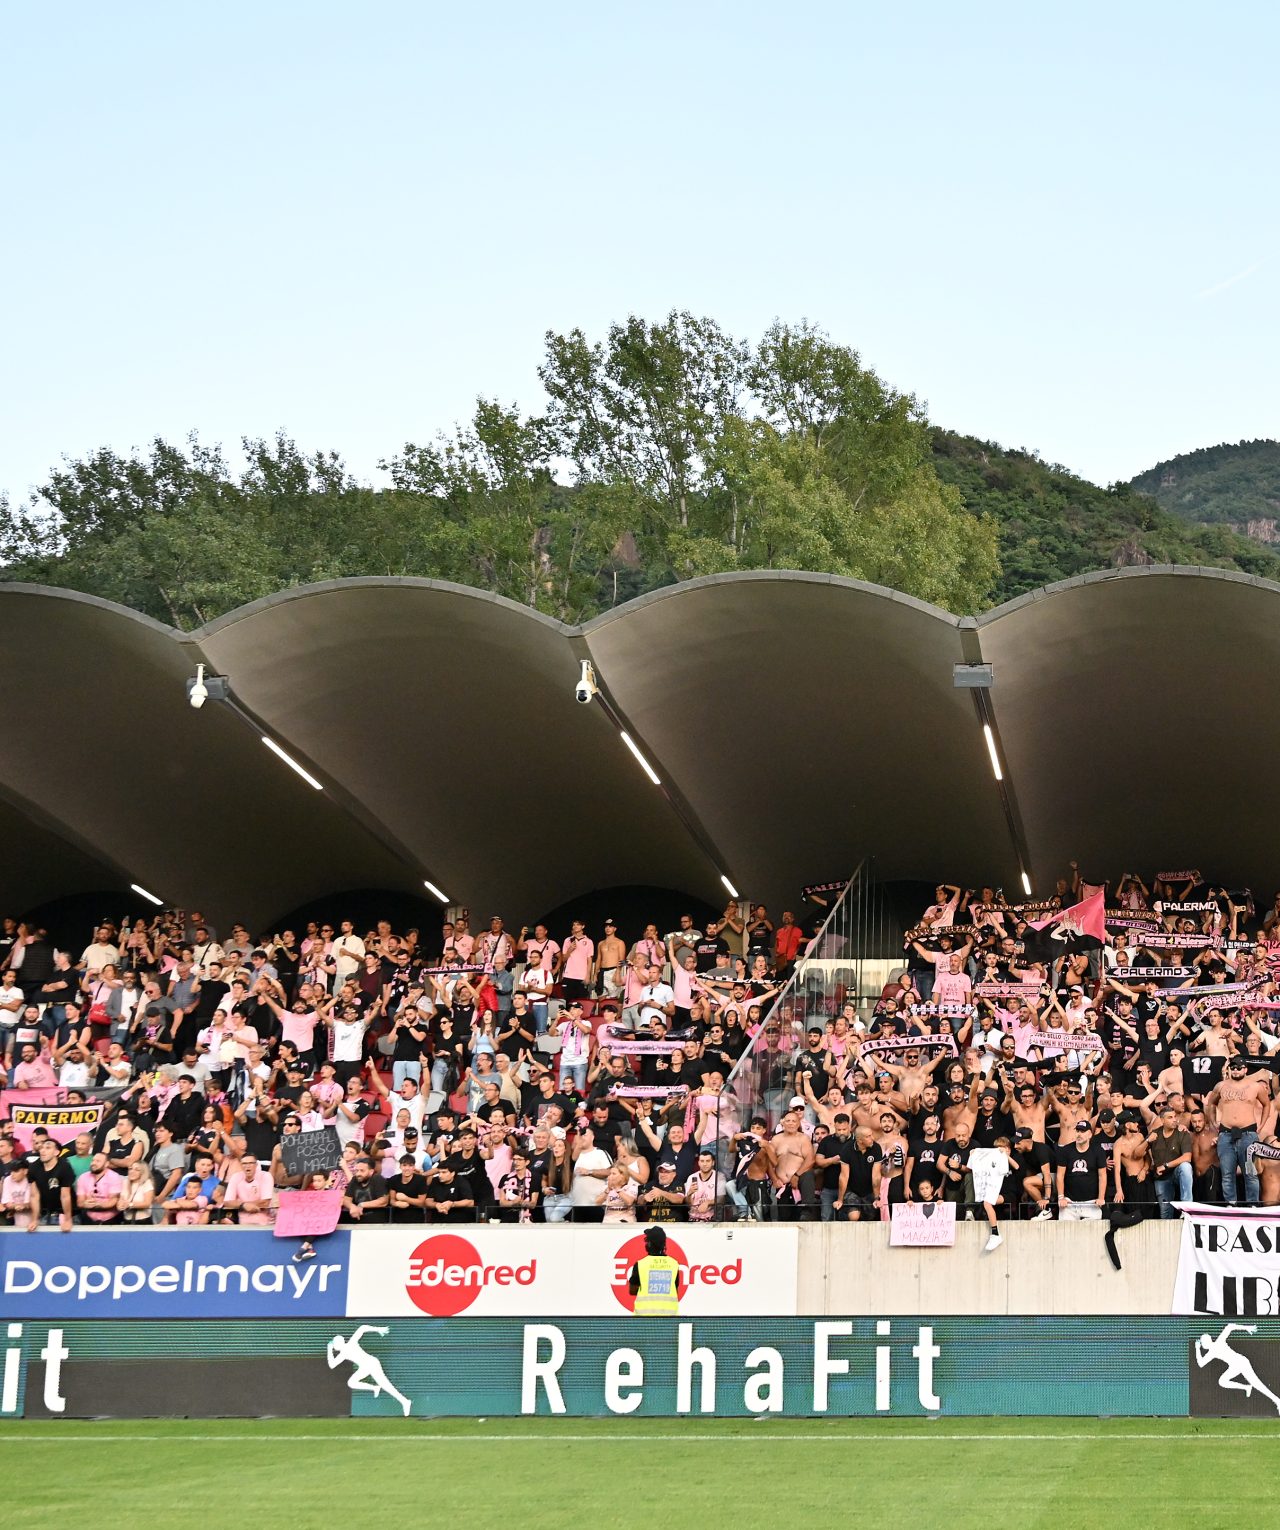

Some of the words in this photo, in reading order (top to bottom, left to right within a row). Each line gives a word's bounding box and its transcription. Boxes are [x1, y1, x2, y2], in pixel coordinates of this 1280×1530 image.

[1162, 901, 1215, 911] PALERMO
[449, 964, 484, 972] PALERMO
[1120, 968, 1182, 976] PALERMO
[1191, 1058, 1211, 1074] 12
[16, 1110, 97, 1125] PALERMO
[296, 1142, 336, 1158] POSSO
[303, 1155, 341, 1172] MAGLI
[4, 1260, 342, 1300] Doppelmayr
[406, 1258, 537, 1286] Edenred
[610, 1258, 742, 1286] Enred
[521, 1321, 941, 1413] RehaFit
